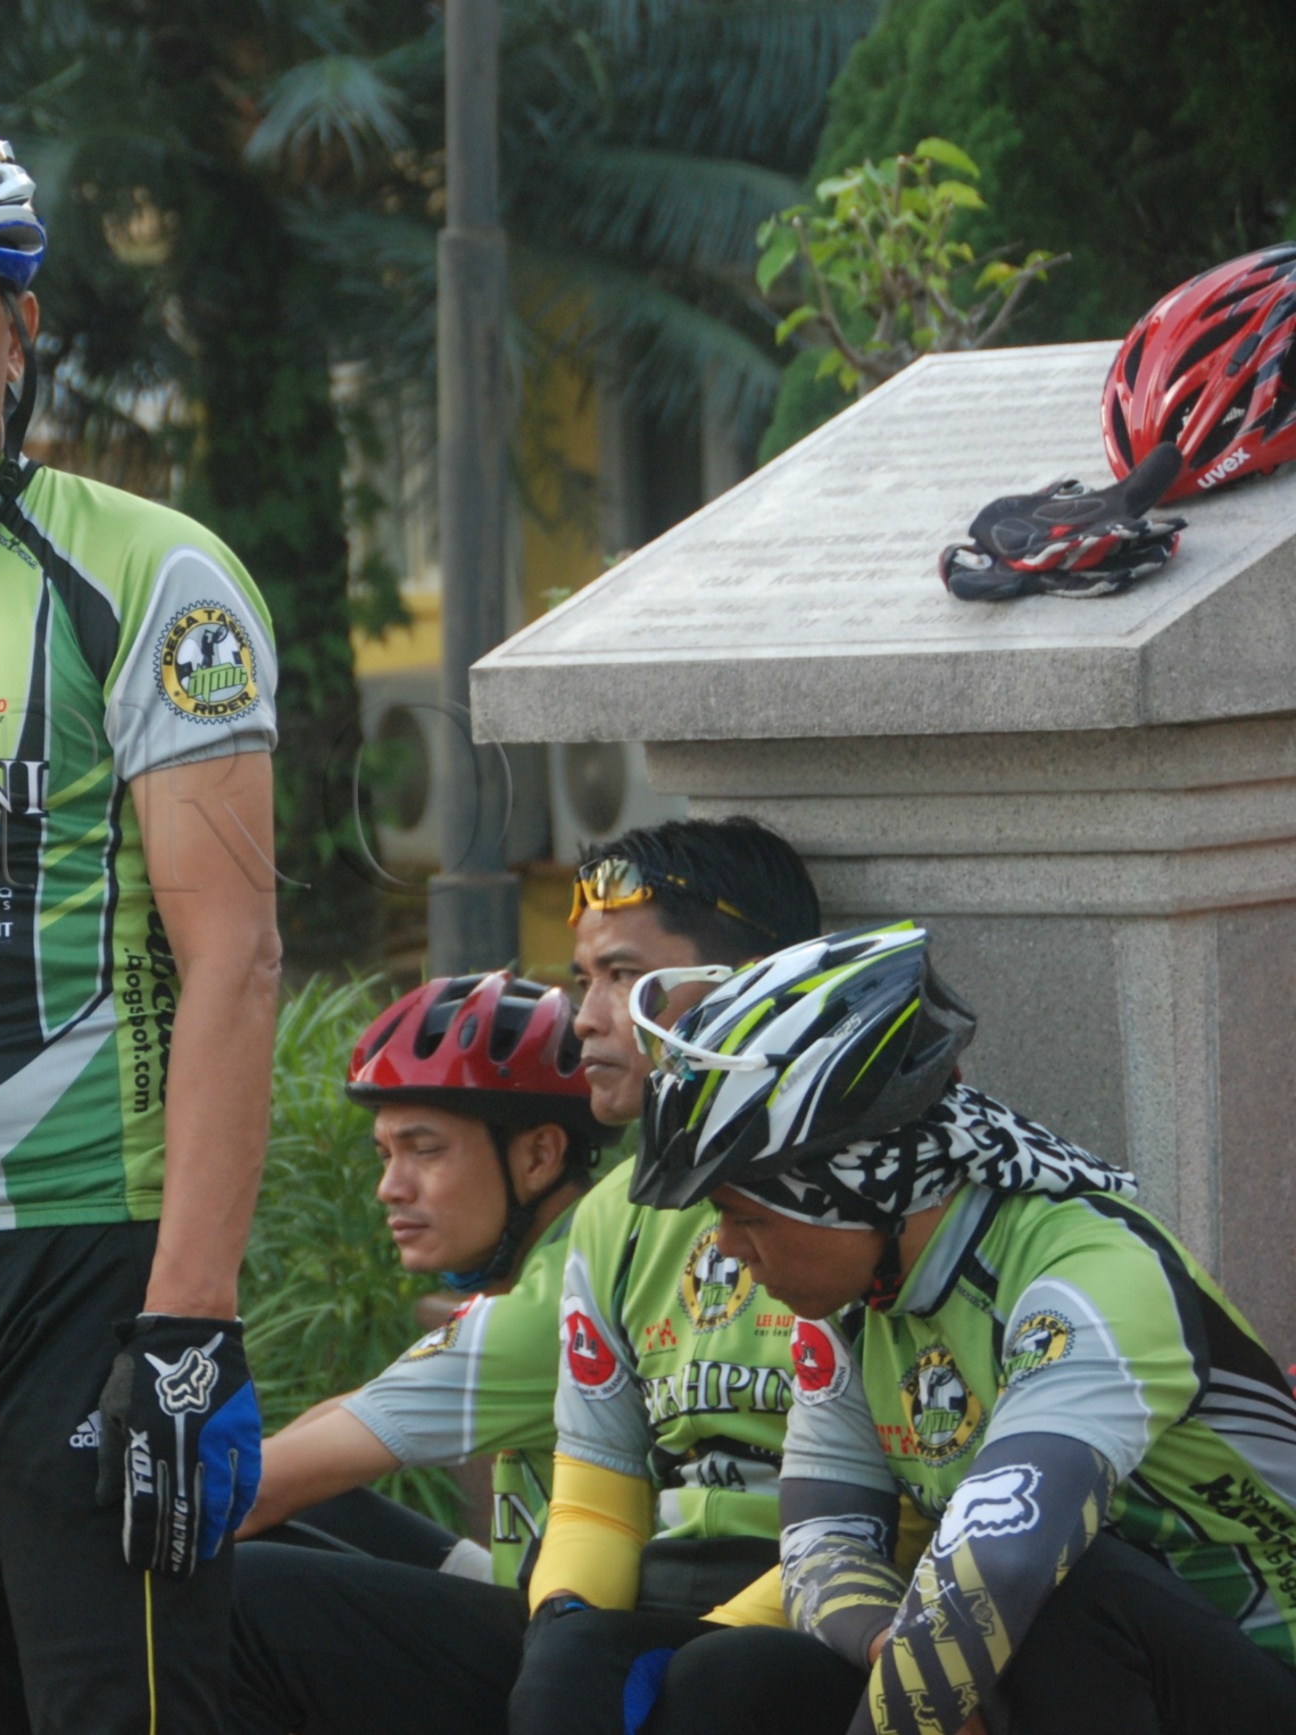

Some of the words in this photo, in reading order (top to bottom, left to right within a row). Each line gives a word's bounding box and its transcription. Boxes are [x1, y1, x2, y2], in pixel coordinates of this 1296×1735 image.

[1197, 446, 1251, 489] uvex
[163, 615, 200, 666] DESA
[192, 691, 252, 715] RIDER
[756, 1314, 773, 1328] LEE
[775, 1314, 798, 1328] AUT
[69, 1433, 100, 1448] adi
[128, 1427, 154, 1497] FOX
[171, 1498, 189, 1564] RACING
